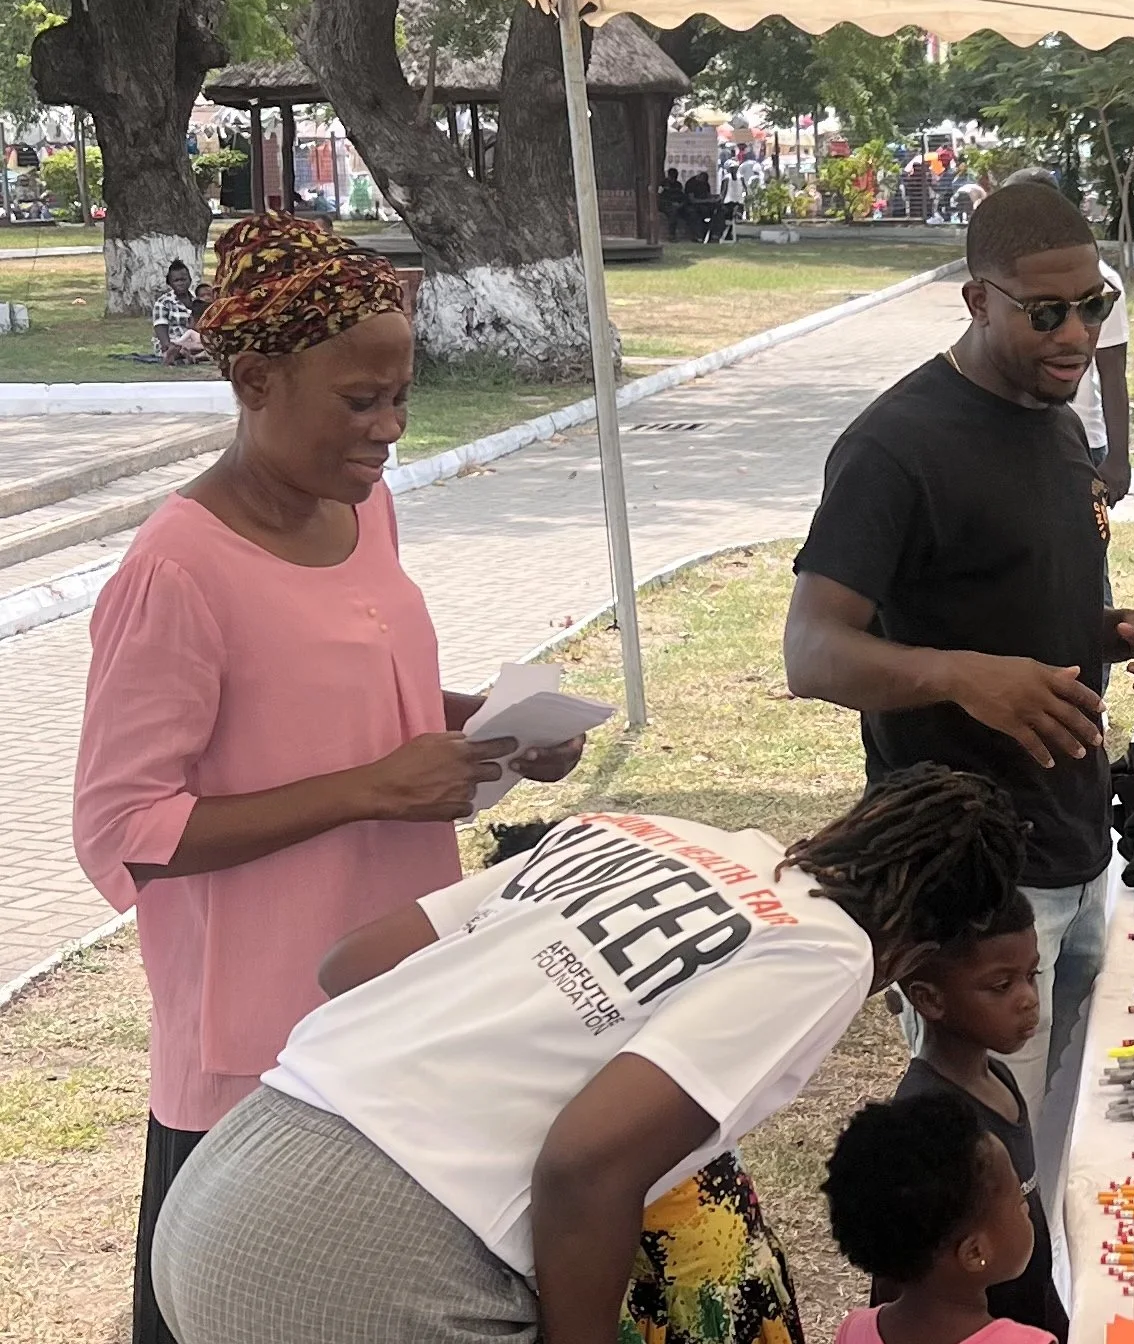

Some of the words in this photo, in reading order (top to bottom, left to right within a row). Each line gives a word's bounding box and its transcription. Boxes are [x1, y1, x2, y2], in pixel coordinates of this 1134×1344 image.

[502, 824, 752, 1006] OLUNTEER
[669, 846, 758, 885] HEALTH
[739, 888, 799, 926] FAIR
[531, 949, 609, 1036] FOUNDATION
[546, 940, 625, 1027] AFROFUTURE
